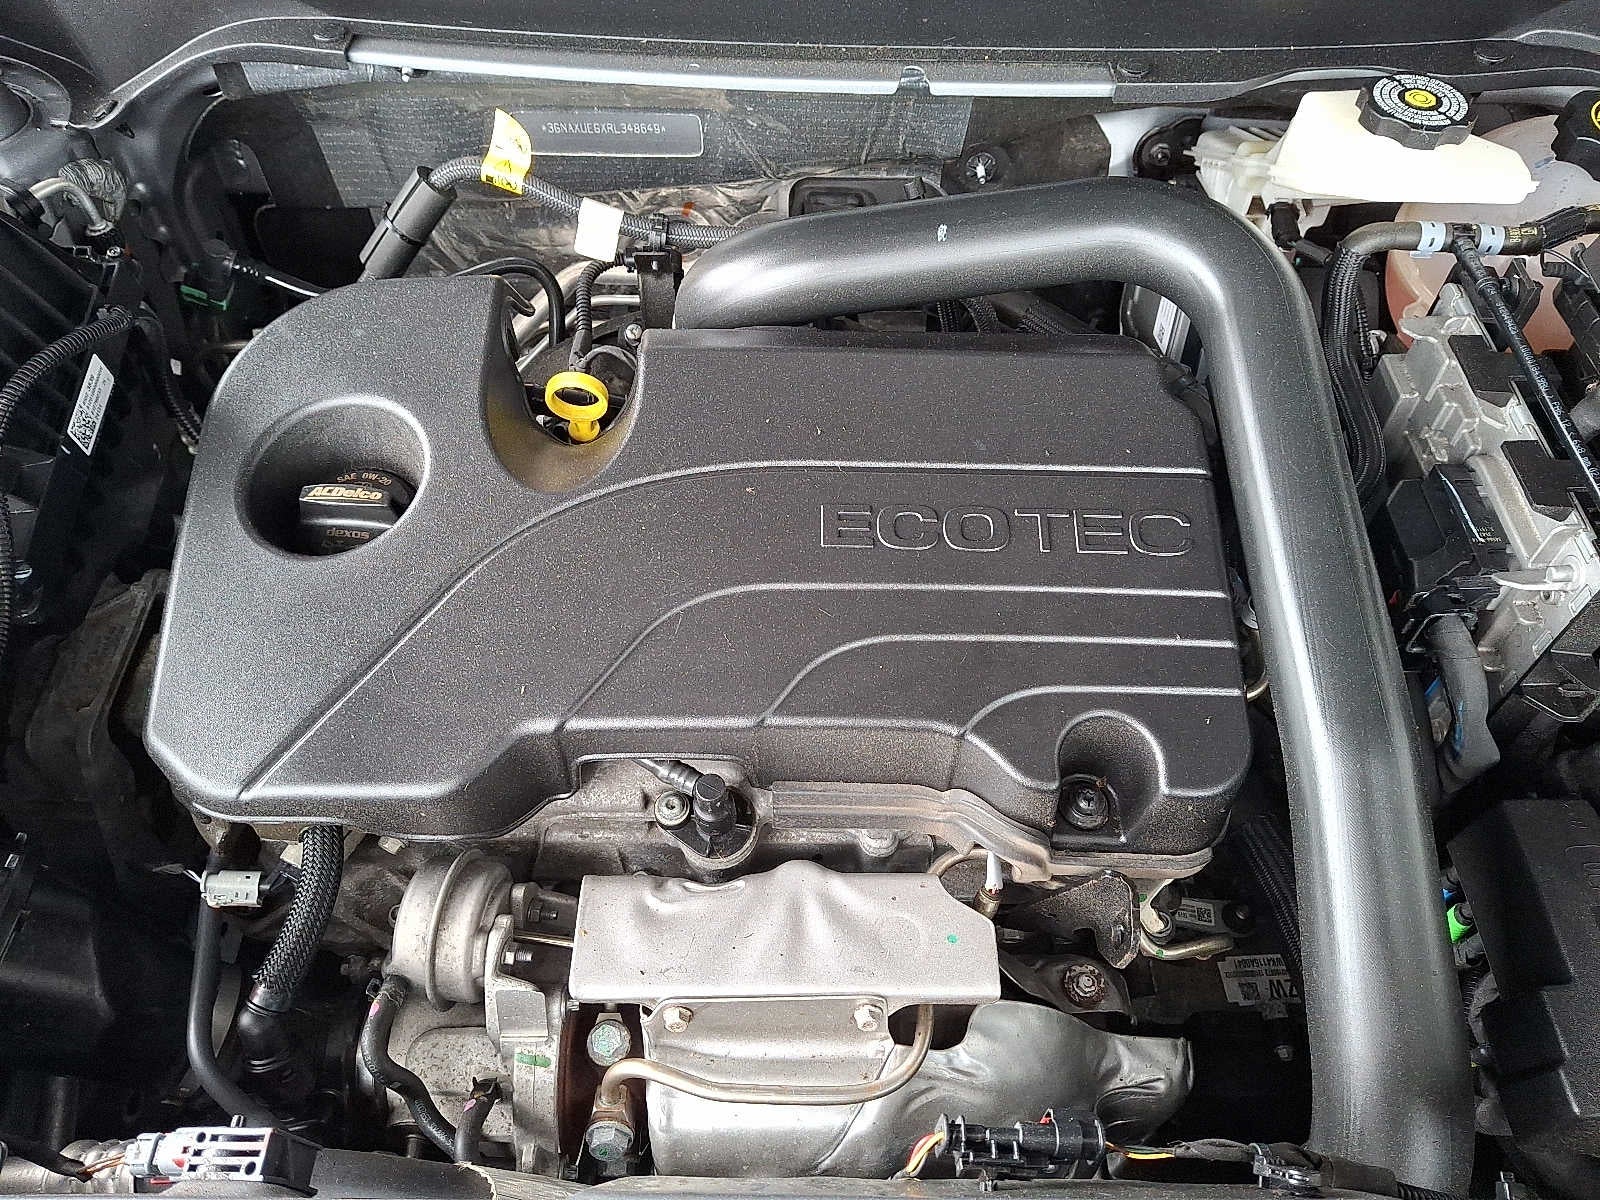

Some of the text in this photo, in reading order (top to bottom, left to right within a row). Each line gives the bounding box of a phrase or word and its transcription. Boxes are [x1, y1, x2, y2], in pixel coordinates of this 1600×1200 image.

[336, 472, 392, 486] SAE 0W-20
[308, 486, 383, 500] ACDelco
[327, 528, 370, 540] dexos
[820, 503, 1194, 557] ECOTEC
